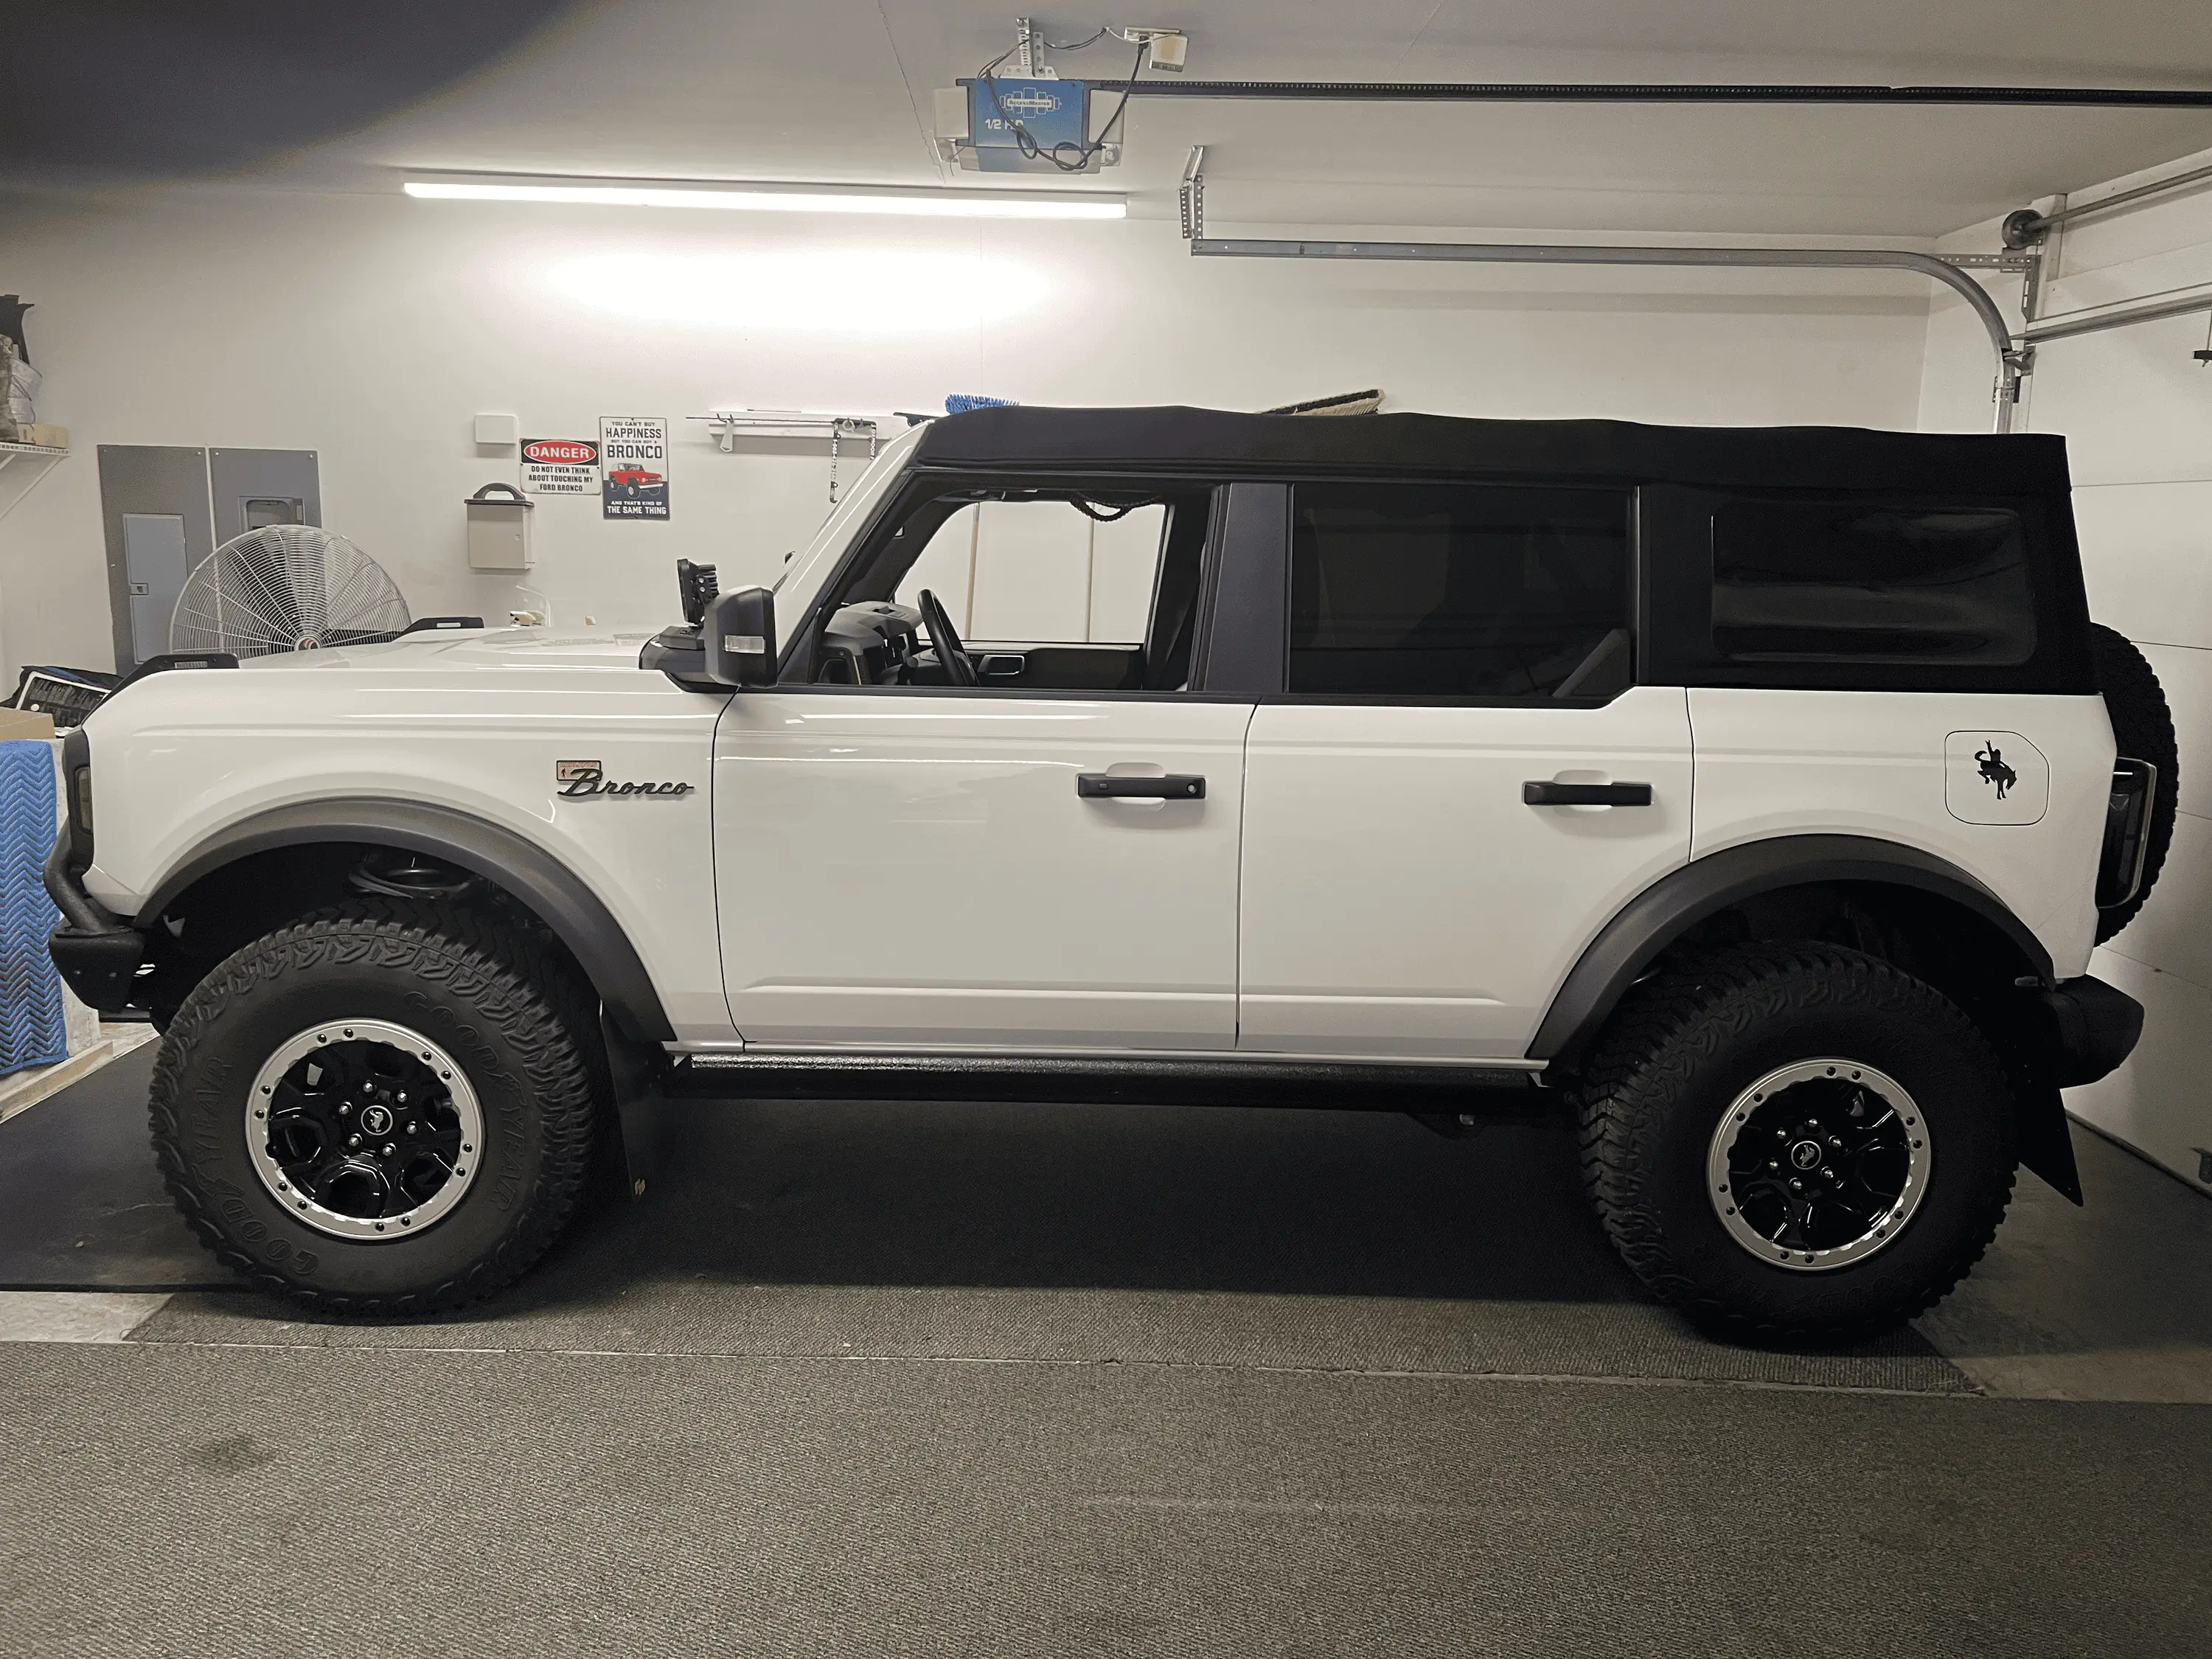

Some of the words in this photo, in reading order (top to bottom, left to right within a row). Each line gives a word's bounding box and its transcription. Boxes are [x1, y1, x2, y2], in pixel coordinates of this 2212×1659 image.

[985, 118, 1002, 130] 1/2
[605, 428, 662, 439] HAPPINESS
[529, 446, 590, 459] DANGER
[607, 445, 663, 459] BRONCO
[607, 506, 621, 514] THE
[622, 506, 643, 514] SAME
[644, 507, 667, 515] THING
[557, 768, 695, 797] Bronco
